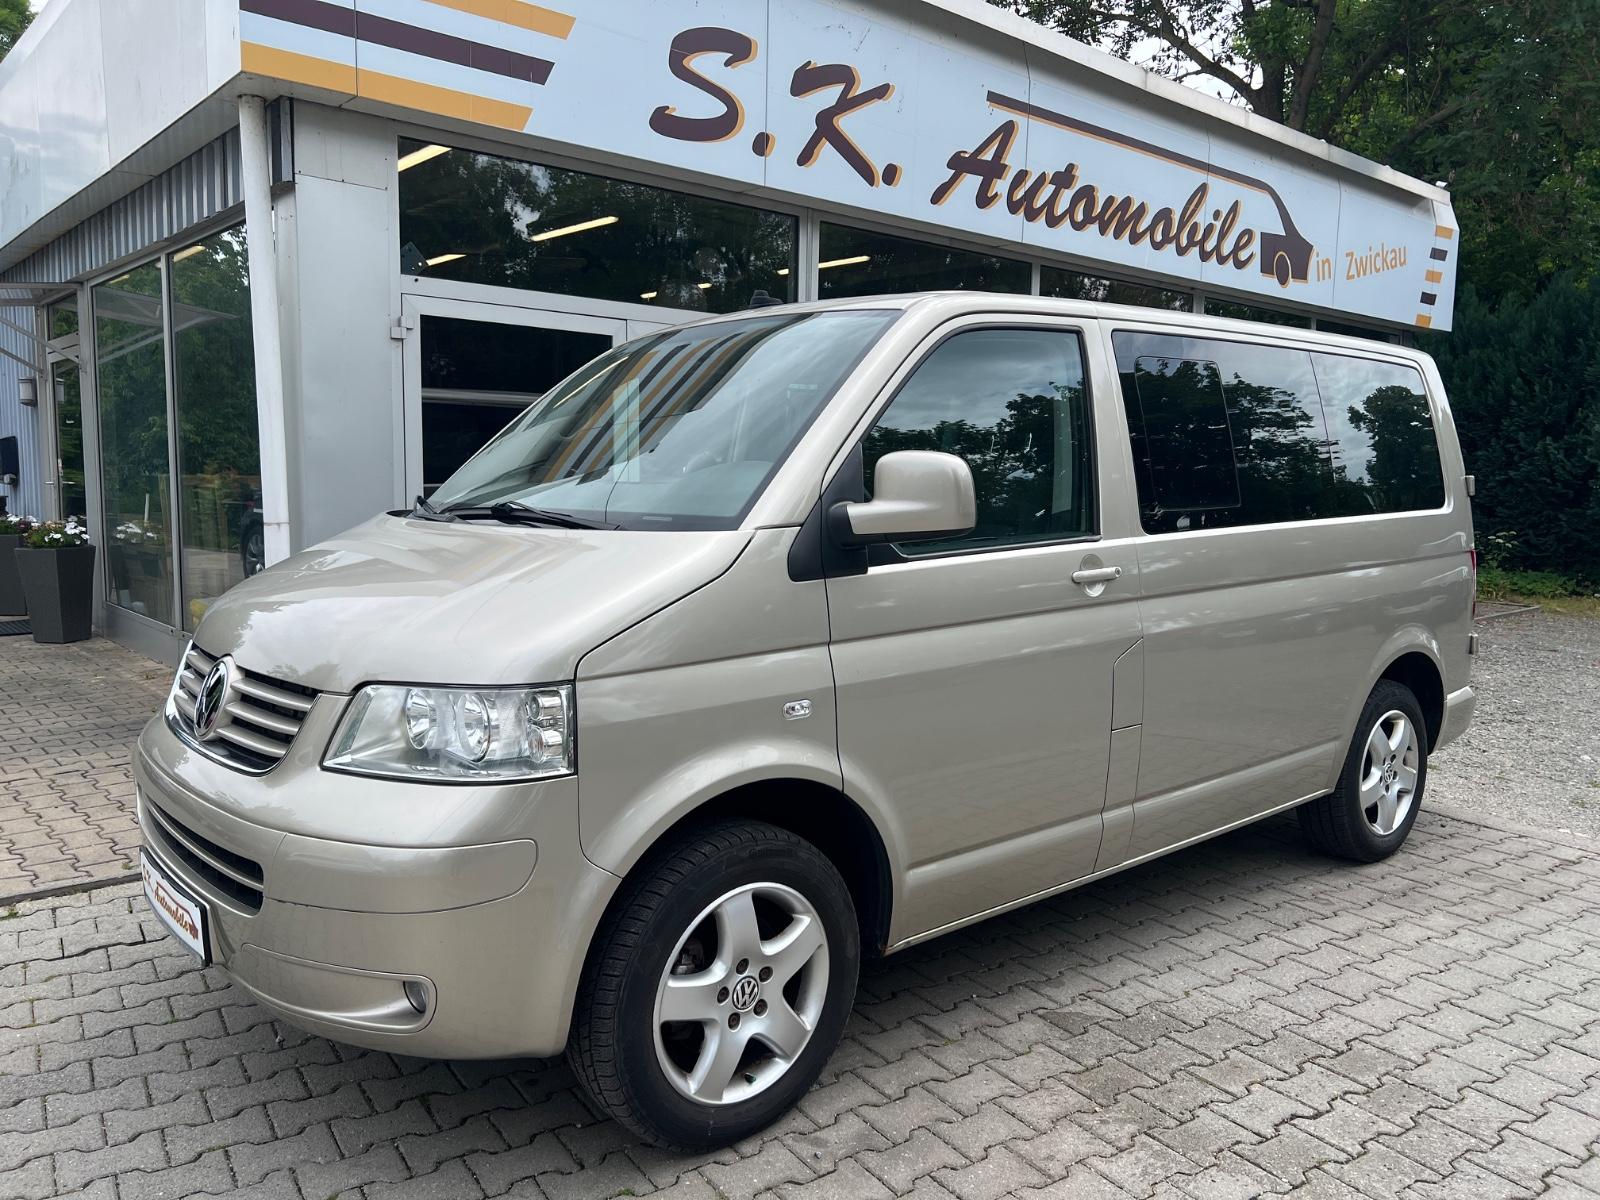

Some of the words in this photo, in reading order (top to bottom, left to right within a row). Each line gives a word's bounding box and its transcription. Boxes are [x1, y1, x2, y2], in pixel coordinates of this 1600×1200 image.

[930, 119, 1256, 270] Automobile
[1316, 251, 1331, 282] in
[1345, 242, 1407, 281] Zwickau
[733, 977, 759, 1011] VW
